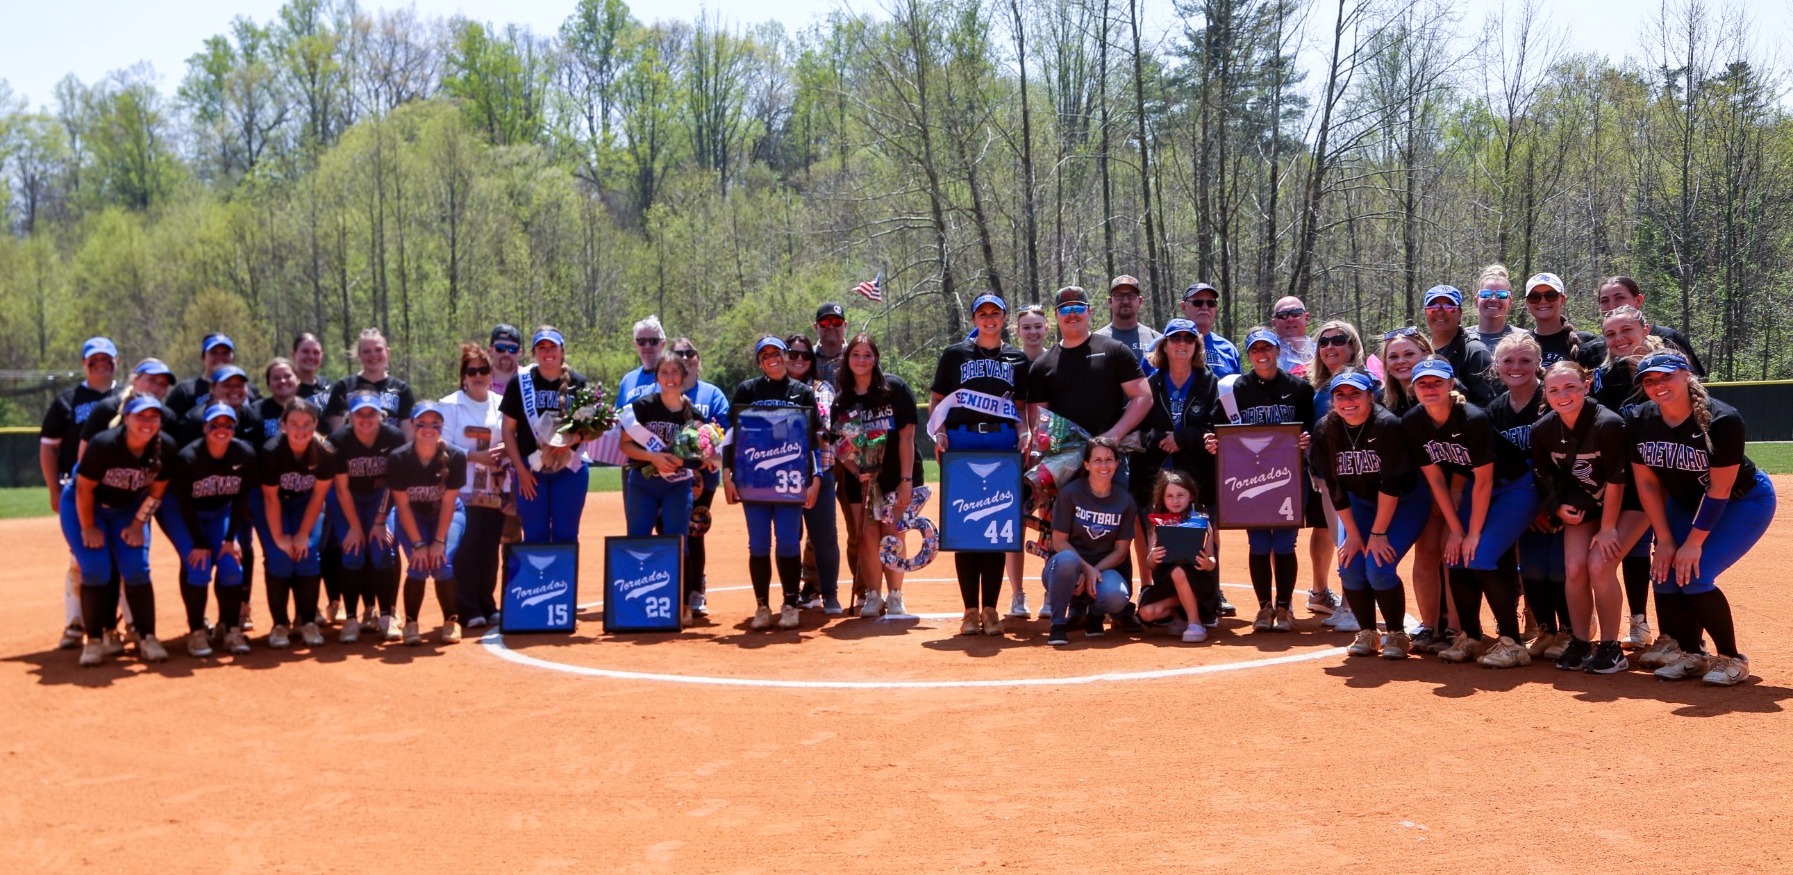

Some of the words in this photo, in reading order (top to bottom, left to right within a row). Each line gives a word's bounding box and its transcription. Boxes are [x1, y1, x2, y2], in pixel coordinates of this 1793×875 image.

[522, 373, 536, 418] SENIOR
[955, 391, 999, 412] SENIOR
[1003, 402, 1022, 418] 20
[744, 442, 802, 462] Tornados
[775, 469, 803, 493] 33
[1224, 466, 1292, 492] Tornados
[952, 489, 1014, 514] Tornados
[1278, 496, 1295, 521] 4
[983, 519, 1014, 544] 44
[511, 579, 568, 600] Tornados
[614, 570, 670, 592] Tornados
[547, 603, 568, 626] 15
[645, 596, 671, 619] 22
